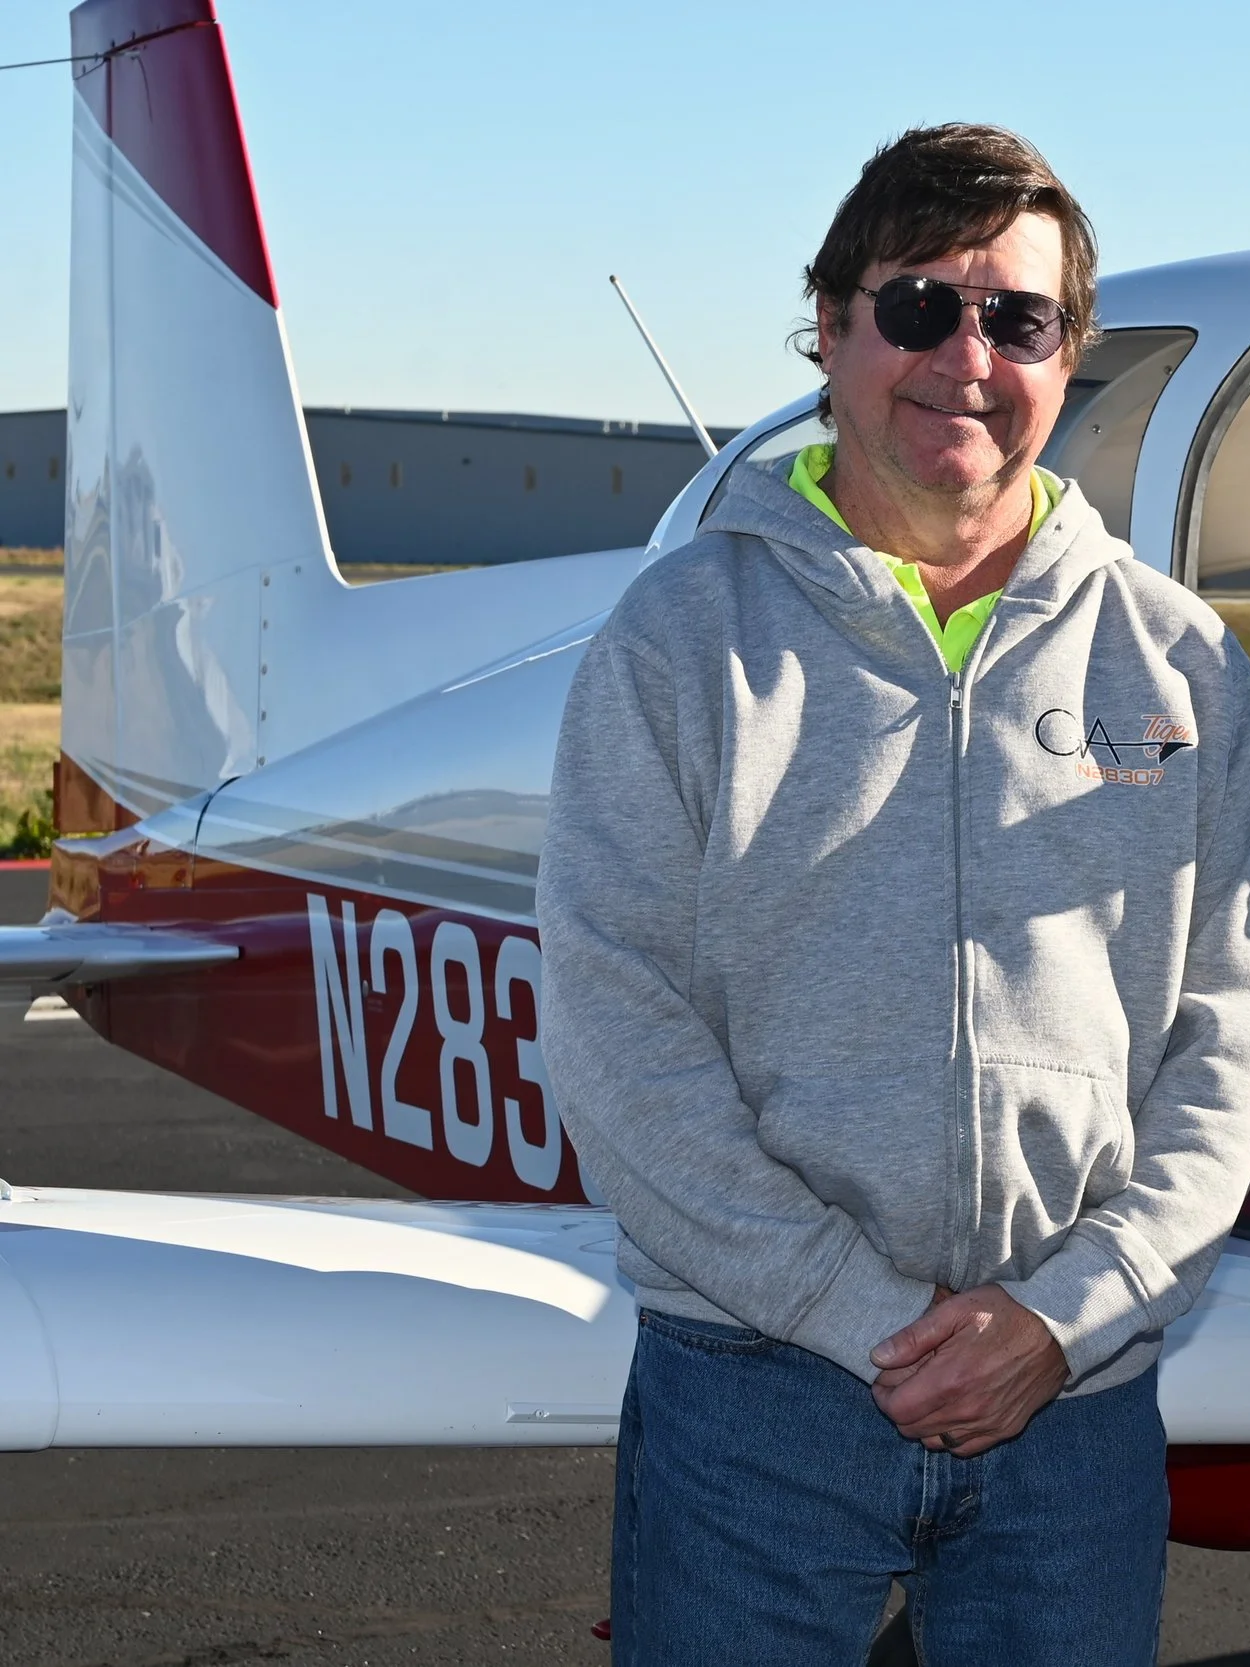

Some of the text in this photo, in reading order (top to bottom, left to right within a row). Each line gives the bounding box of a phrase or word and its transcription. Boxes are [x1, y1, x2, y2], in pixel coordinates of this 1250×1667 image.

[1141, 714, 1190, 758] Tiger
[1076, 763, 1165, 785] N28307
[306, 892, 604, 1204] N283
